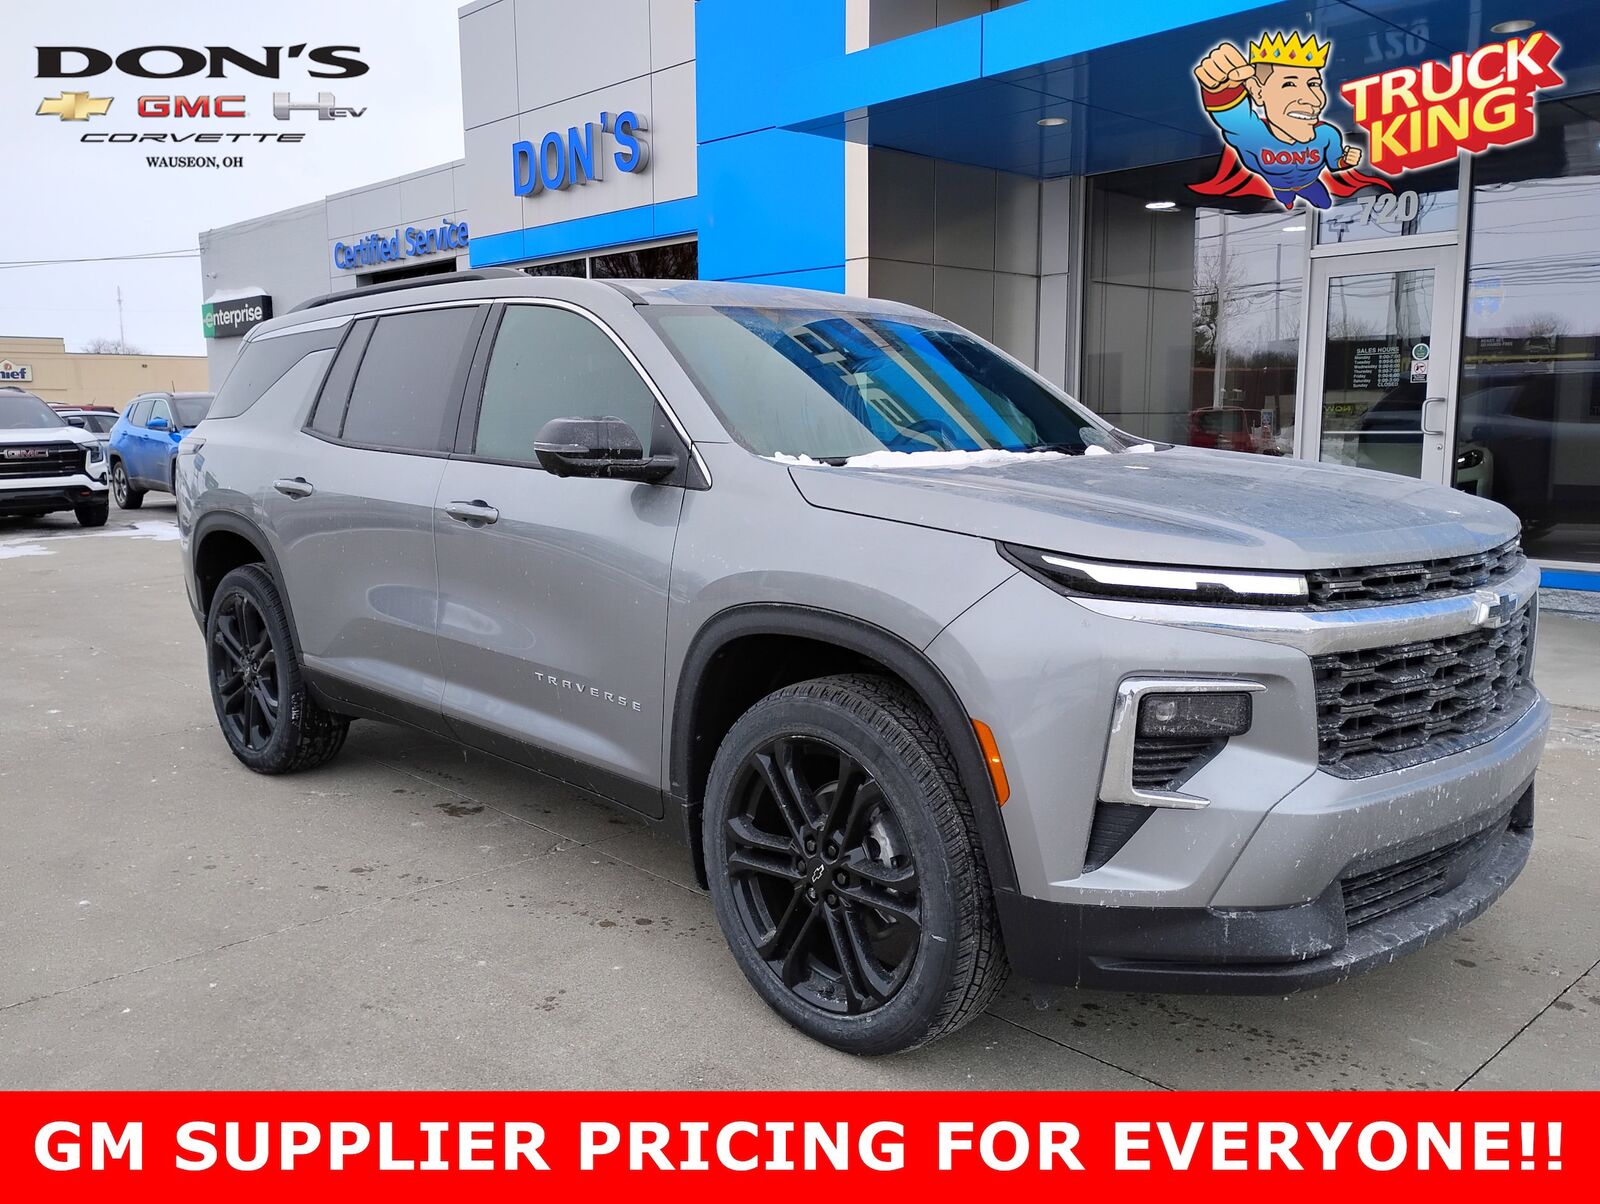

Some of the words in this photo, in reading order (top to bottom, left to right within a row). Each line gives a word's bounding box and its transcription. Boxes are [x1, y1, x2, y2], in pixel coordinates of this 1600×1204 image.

[512, 111, 649, 197] DON'S
[1357, 191, 1419, 225] 720
[334, 229, 400, 269] Certified
[405, 219, 468, 256] Service
[205, 303, 263, 329] enterprise
[535, 672, 641, 711] TRAVERSE
